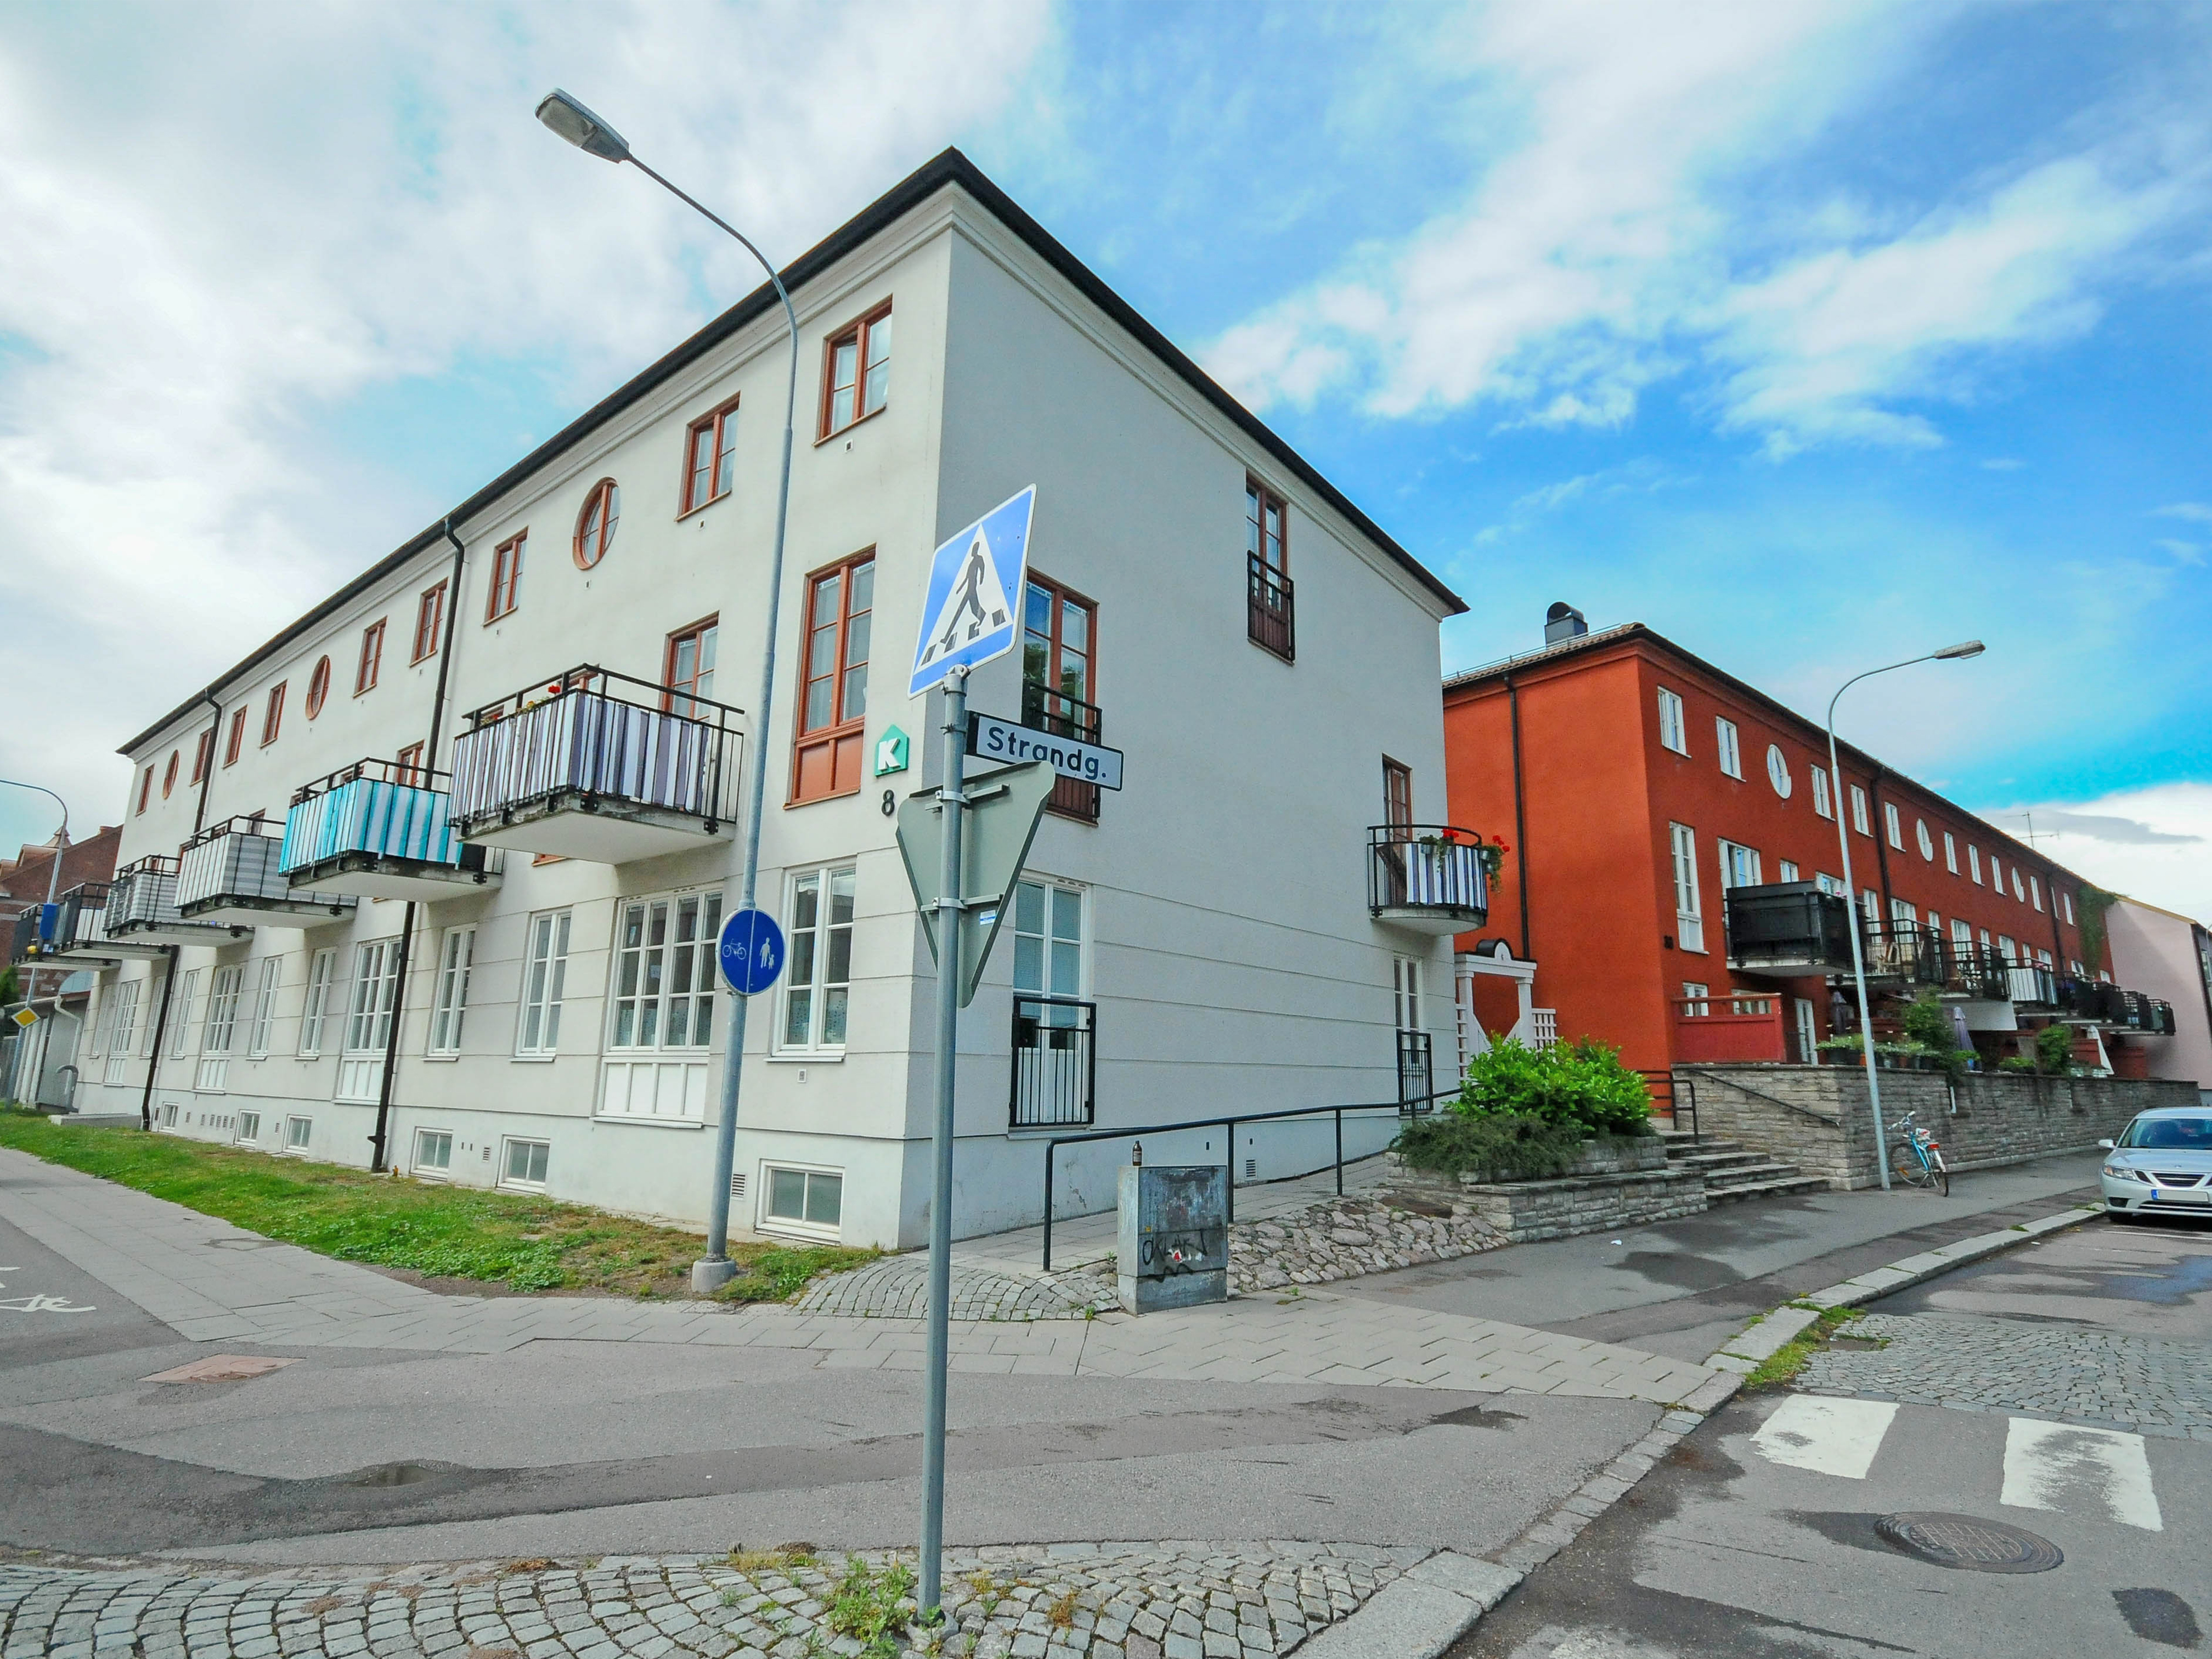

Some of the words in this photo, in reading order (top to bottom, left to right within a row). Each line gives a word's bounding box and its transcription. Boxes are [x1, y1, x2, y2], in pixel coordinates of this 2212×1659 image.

[878, 738, 901, 770] K
[987, 726, 1107, 780] Strandg.
[882, 789, 895, 816] 8
